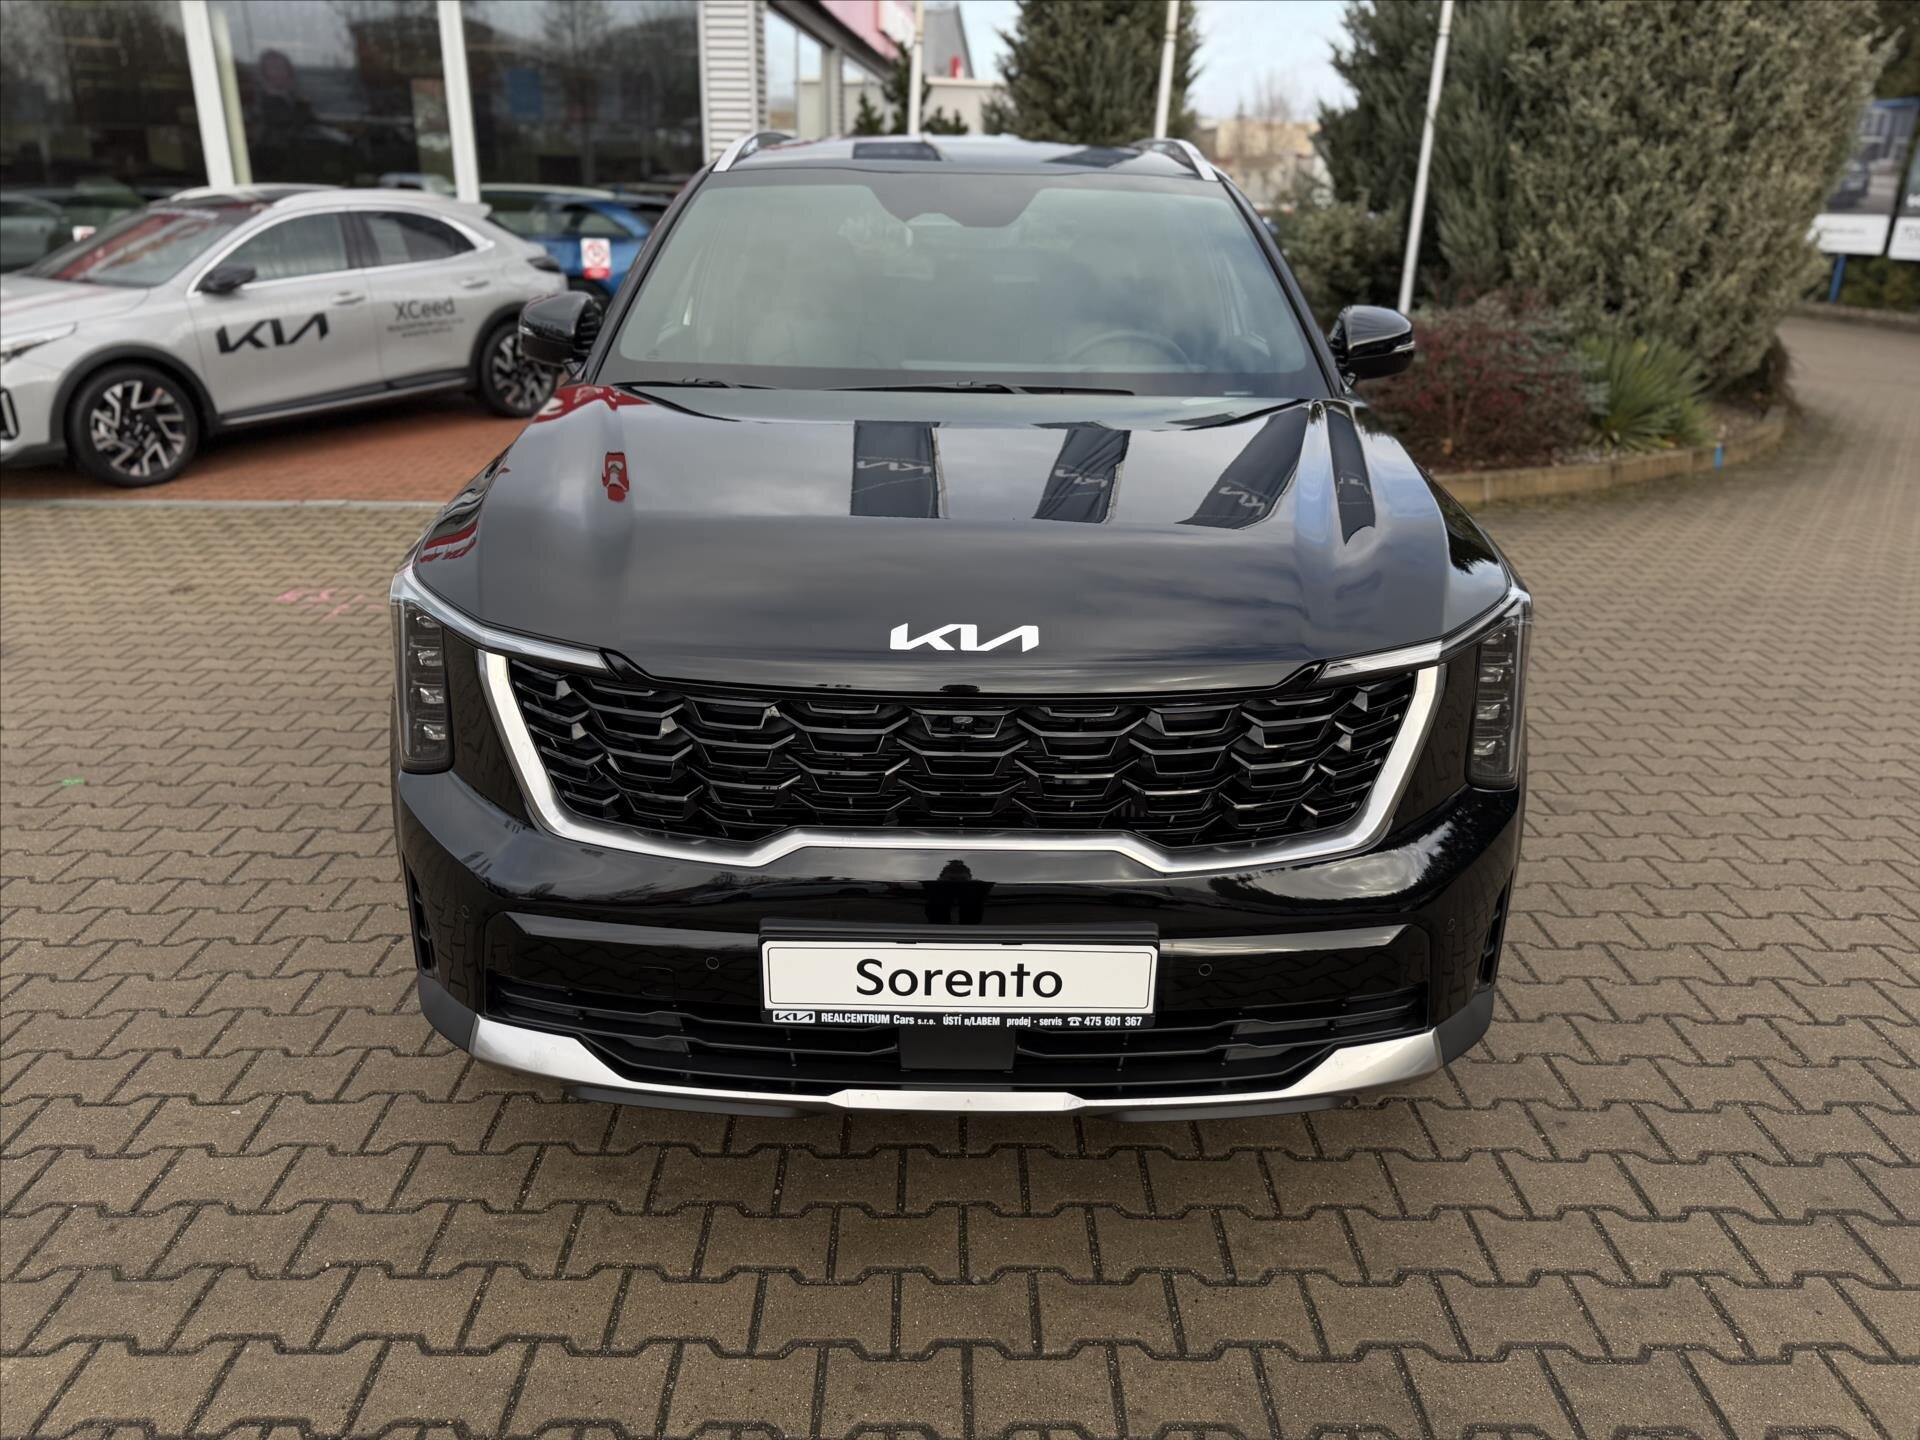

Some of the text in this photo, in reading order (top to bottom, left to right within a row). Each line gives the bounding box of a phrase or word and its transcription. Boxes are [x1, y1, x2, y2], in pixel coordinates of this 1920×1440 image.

[392, 297, 456, 320] XCeed
[216, 312, 329, 354] KIA
[889, 622, 1040, 653] KIA
[856, 958, 1063, 998] Sorento
[774, 1011, 814, 1023] KIA
[821, 1012, 890, 1024] REALCENTRUM
[893, 1014, 915, 1025] Cars
[917, 1017, 936, 1025] s.r.o.
[943, 1014, 962, 1026] ÚSTÍ
[964, 1016, 1000, 1027] n/LABEM
[1006, 1016, 1031, 1028] prodej
[1039, 1016, 1063, 1026] servis
[1084, 1016, 1102, 1026] 475
[1104, 1016, 1121, 1026] 601
[1124, 1016, 1142, 1027] 367
